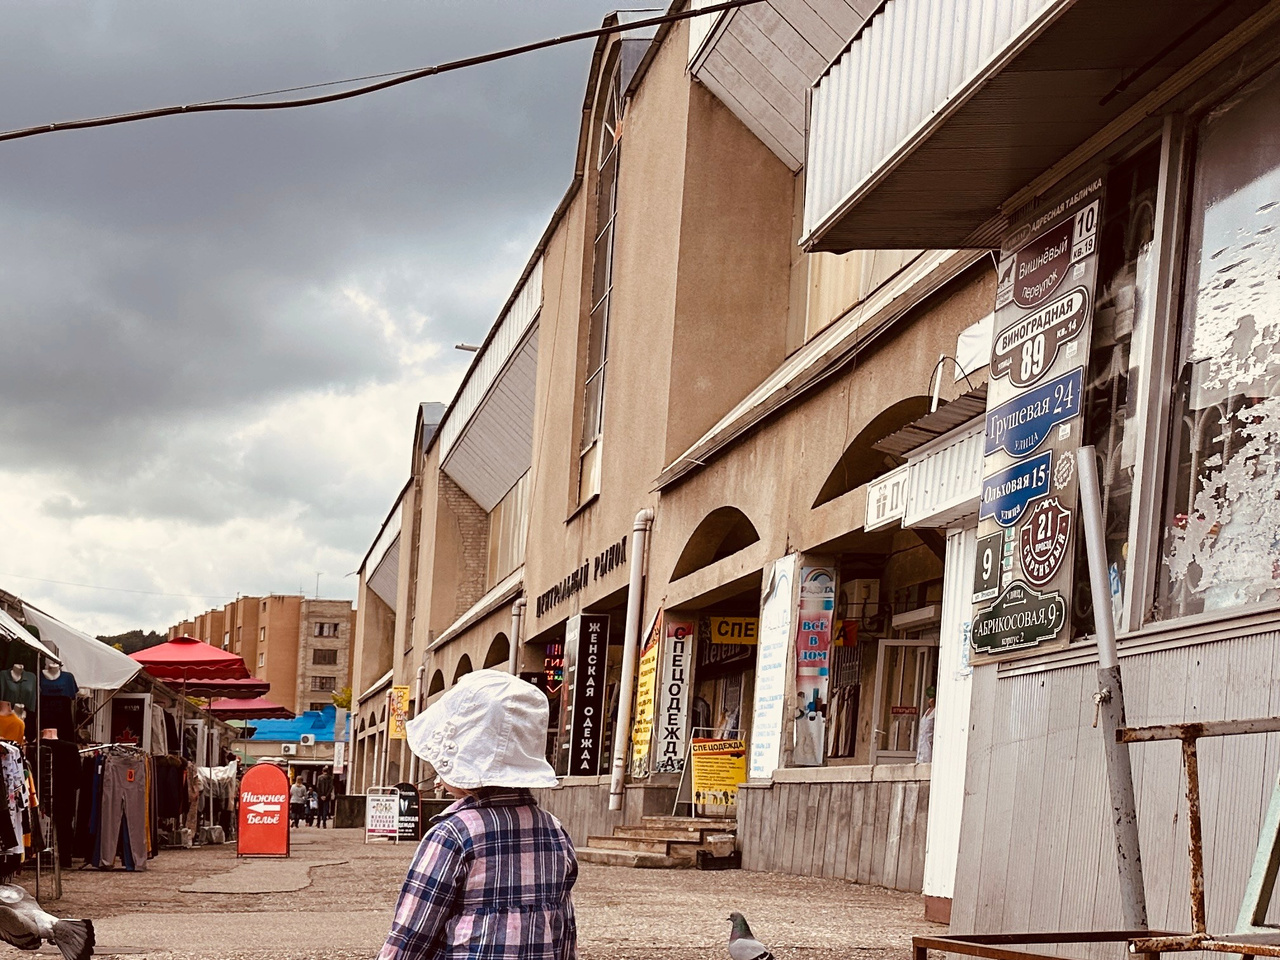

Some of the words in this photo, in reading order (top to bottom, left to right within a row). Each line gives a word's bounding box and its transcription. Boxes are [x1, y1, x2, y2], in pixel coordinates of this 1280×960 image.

[1031, 205, 1065, 232] АДРЕСНАЯ
[1065, 178, 1102, 210] ТАБЛИЧКА
[1077, 206, 1095, 238] 10
[1019, 235, 1068, 280] Вишнёвый
[1085, 238, 1094, 253] 19
[1022, 268, 1058, 302] переулок
[1002, 298, 1074, 351] ВИНОГРАДНАЯ
[1068, 319, 1077, 333] 14
[1020, 333, 1045, 381] 89
[990, 396, 1051, 445] Грушевая
[1053, 379, 1074, 415] 24
[1014, 432, 1039, 451] УЛИЦА
[984, 473, 1030, 504] Ольховая
[1031, 464, 1046, 489] 15
[1037, 511, 1053, 540] 21
[536, 558, 589, 618] ЦЕНТРАЛЬНЫЙ
[594, 535, 627, 581] РЫНОК
[982, 548, 993, 581] 9
[802, 617, 828, 632] ВСЁ
[1048, 603, 1057, 629] 9
[799, 650, 828, 662] ДОМ
[809, 635, 819, 646] В
[585, 623, 601, 697] ЖЕНСКАЯ
[663, 626, 687, 771] СПЕЦОДЕЖДА
[580, 706, 593, 770] ОДЕЖДА
[692, 741, 744, 752] СПЕЦОДЕЖДА
[241, 791, 286, 803] Нижнее
[247, 812, 280, 824] Бельё
